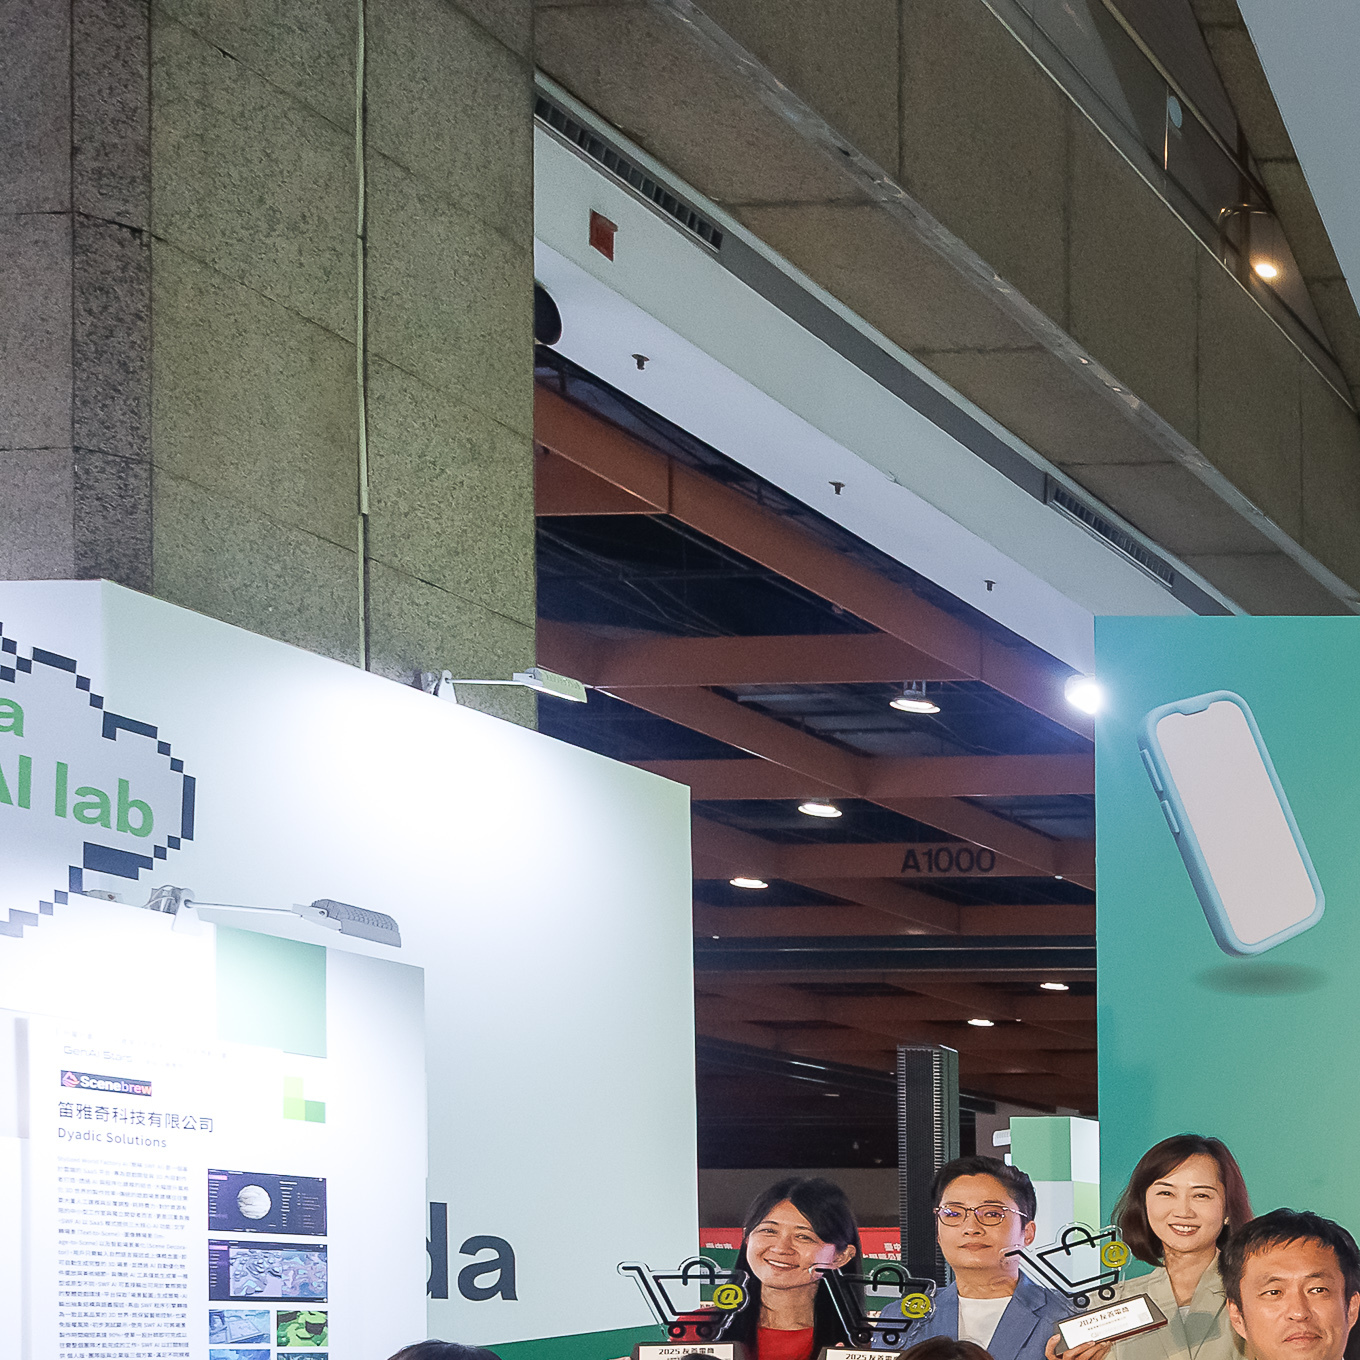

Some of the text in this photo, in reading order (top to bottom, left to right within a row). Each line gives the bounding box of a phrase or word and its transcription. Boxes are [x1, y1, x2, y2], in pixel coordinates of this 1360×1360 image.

[55, 761, 154, 838] lab
[901, 847, 996, 875] A1000
[79, 1075, 152, 1096] Scenebrew
[58, 1101, 214, 1133] 笛雅奇科技有限公司
[58, 1127, 167, 1149] Dyadic Solutions
